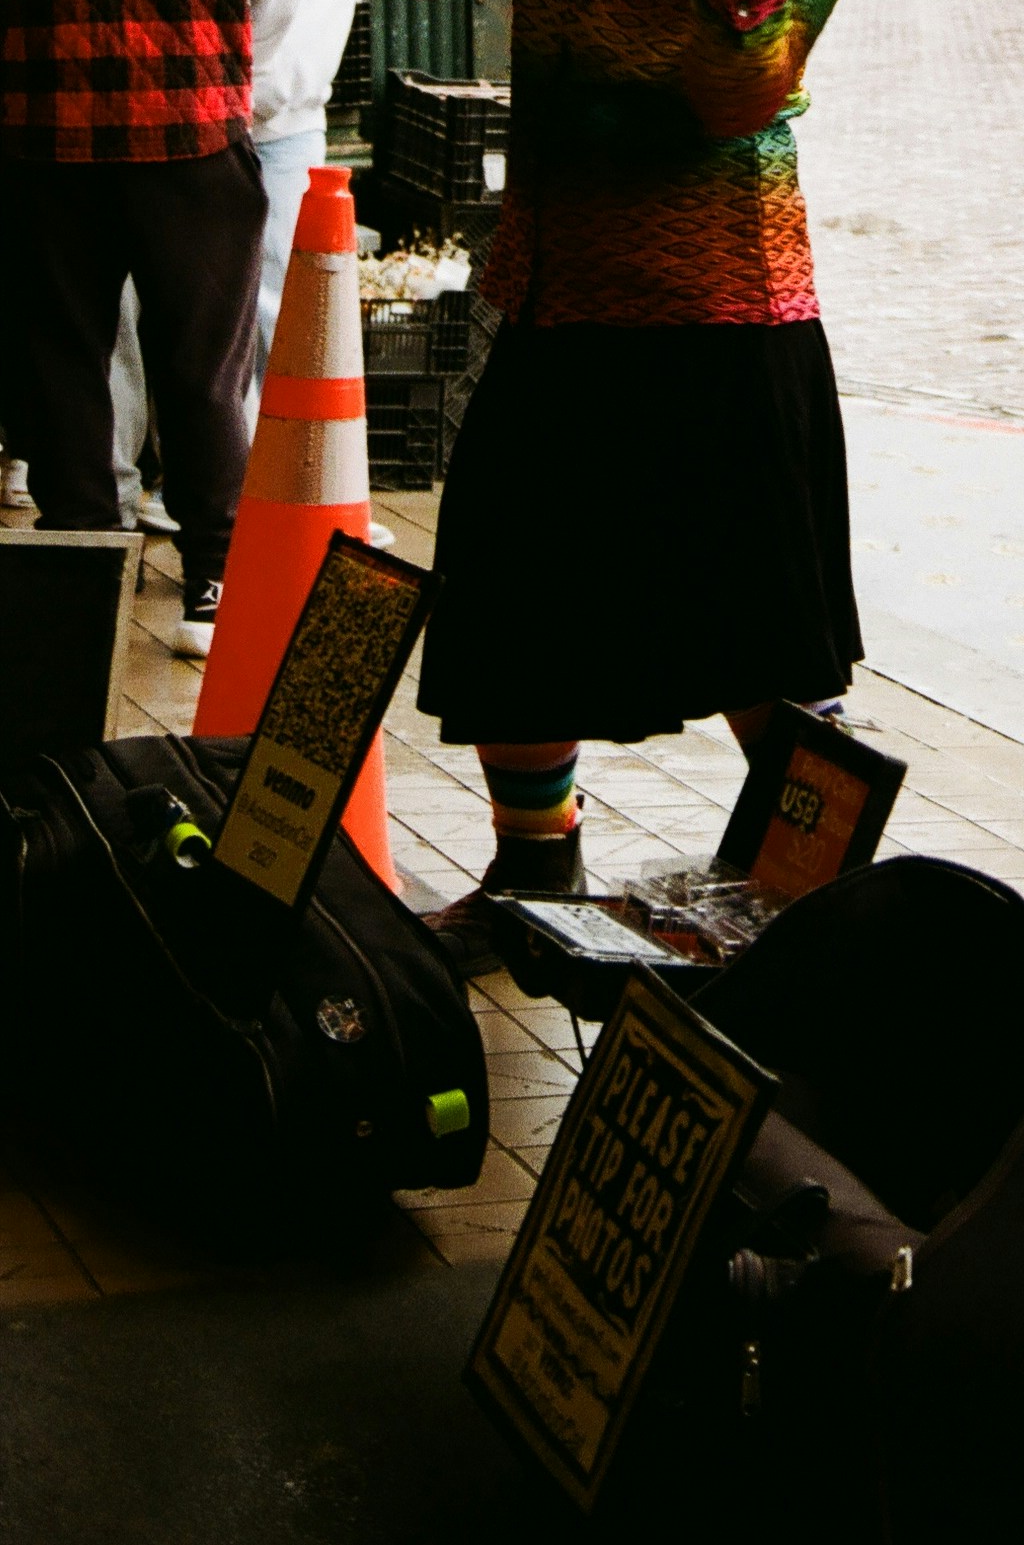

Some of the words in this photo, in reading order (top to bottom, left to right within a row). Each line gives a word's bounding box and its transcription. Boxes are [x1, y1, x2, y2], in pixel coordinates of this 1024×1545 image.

[264, 765, 316, 811] venmo
[781, 783, 819, 824] USB
[584, 1113, 626, 1192] TIP
[616, 1160, 674, 1253] FOR
[602, 1053, 706, 1186] PLEASE
[554, 1177, 651, 1308] PHOTOS
